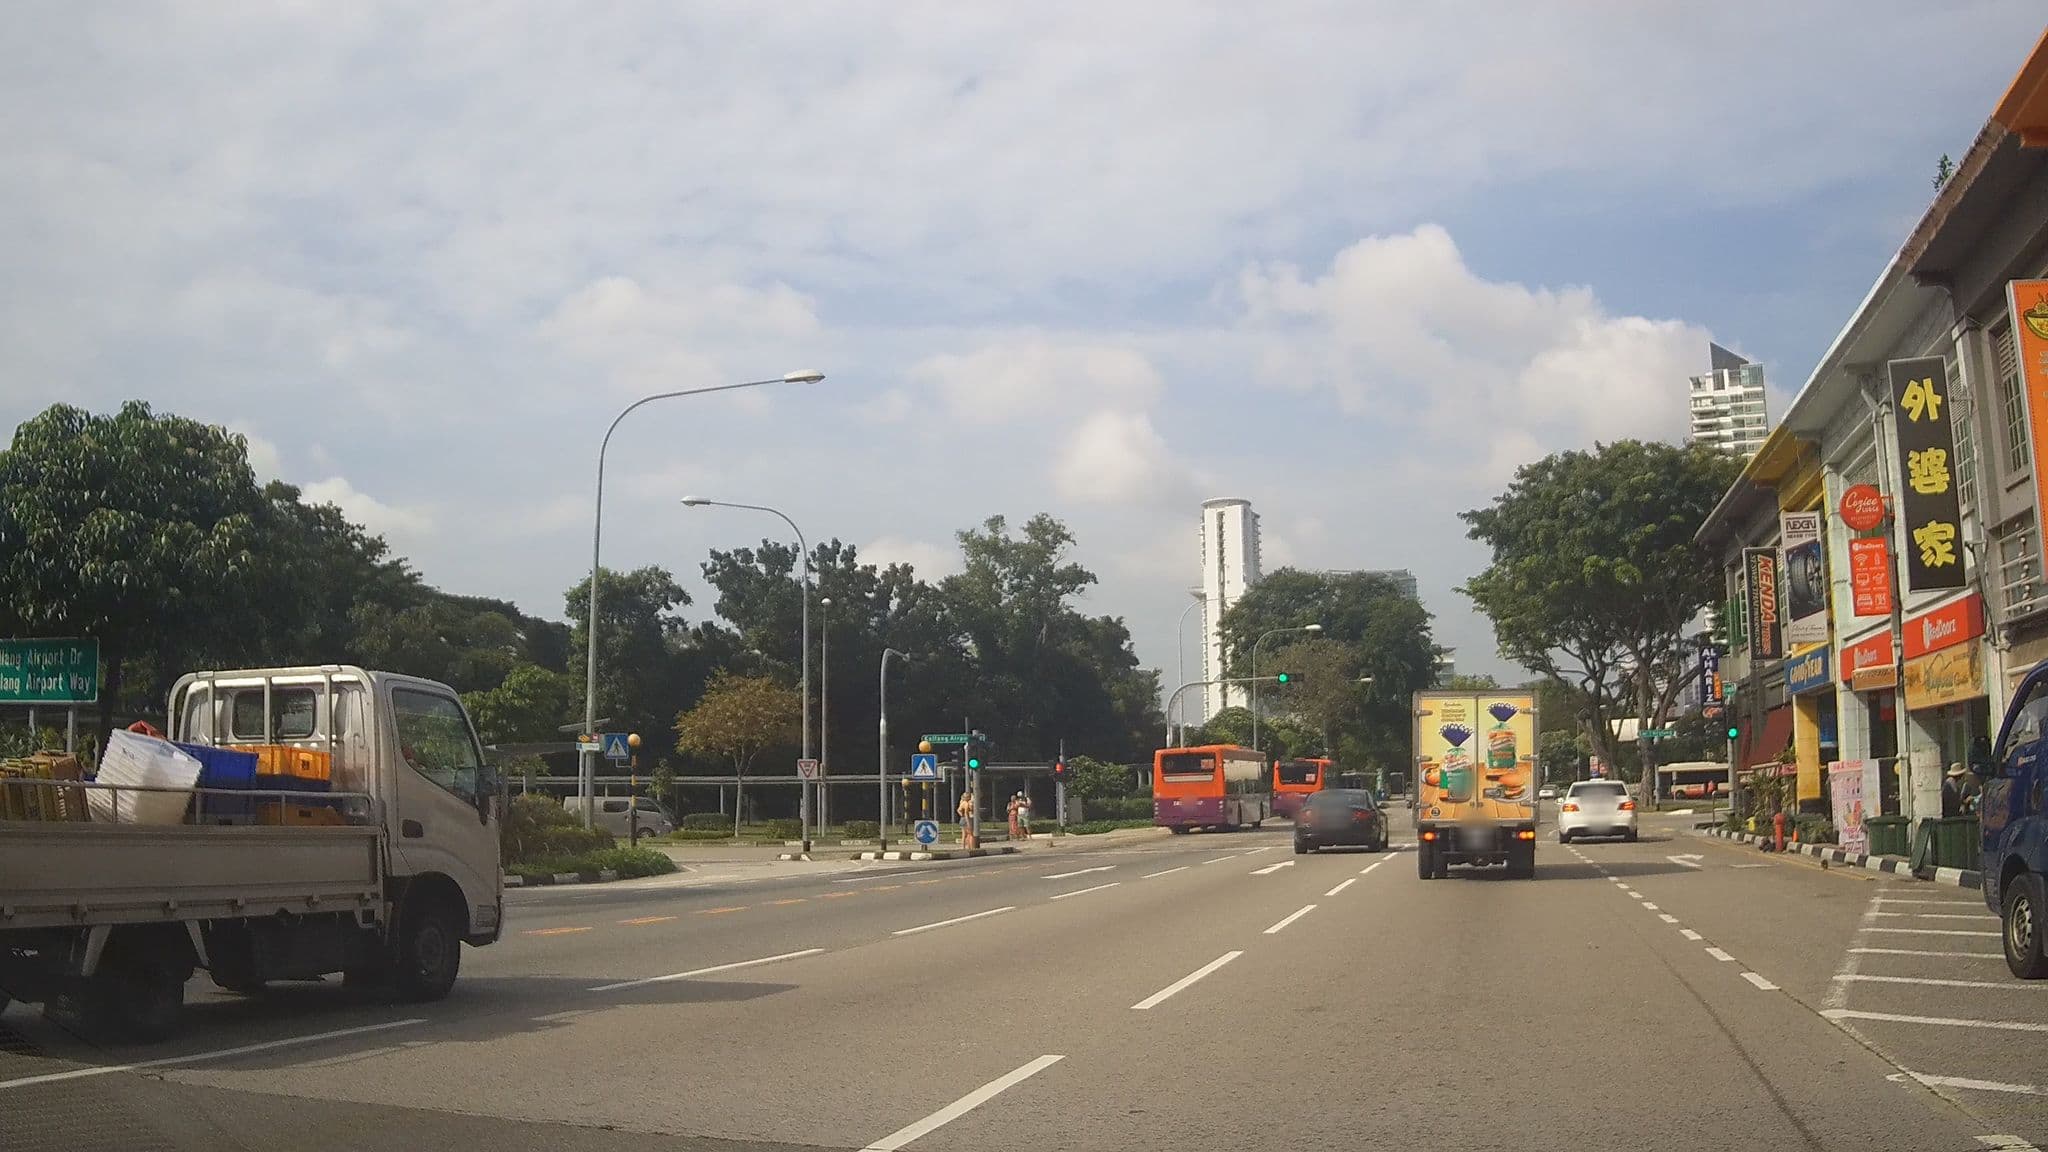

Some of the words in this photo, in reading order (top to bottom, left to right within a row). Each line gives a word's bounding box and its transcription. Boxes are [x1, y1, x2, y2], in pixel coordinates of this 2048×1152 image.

[1901, 377, 1956, 568] 外婆家
[1785, 520, 1817, 531] NEXEN
[1758, 554, 1777, 622] KENDA
[28, 648, 64, 670] Airport
[70, 648, 82, 665] Dr
[26, 673, 63, 695] Airport
[70, 673, 90, 694] Way
